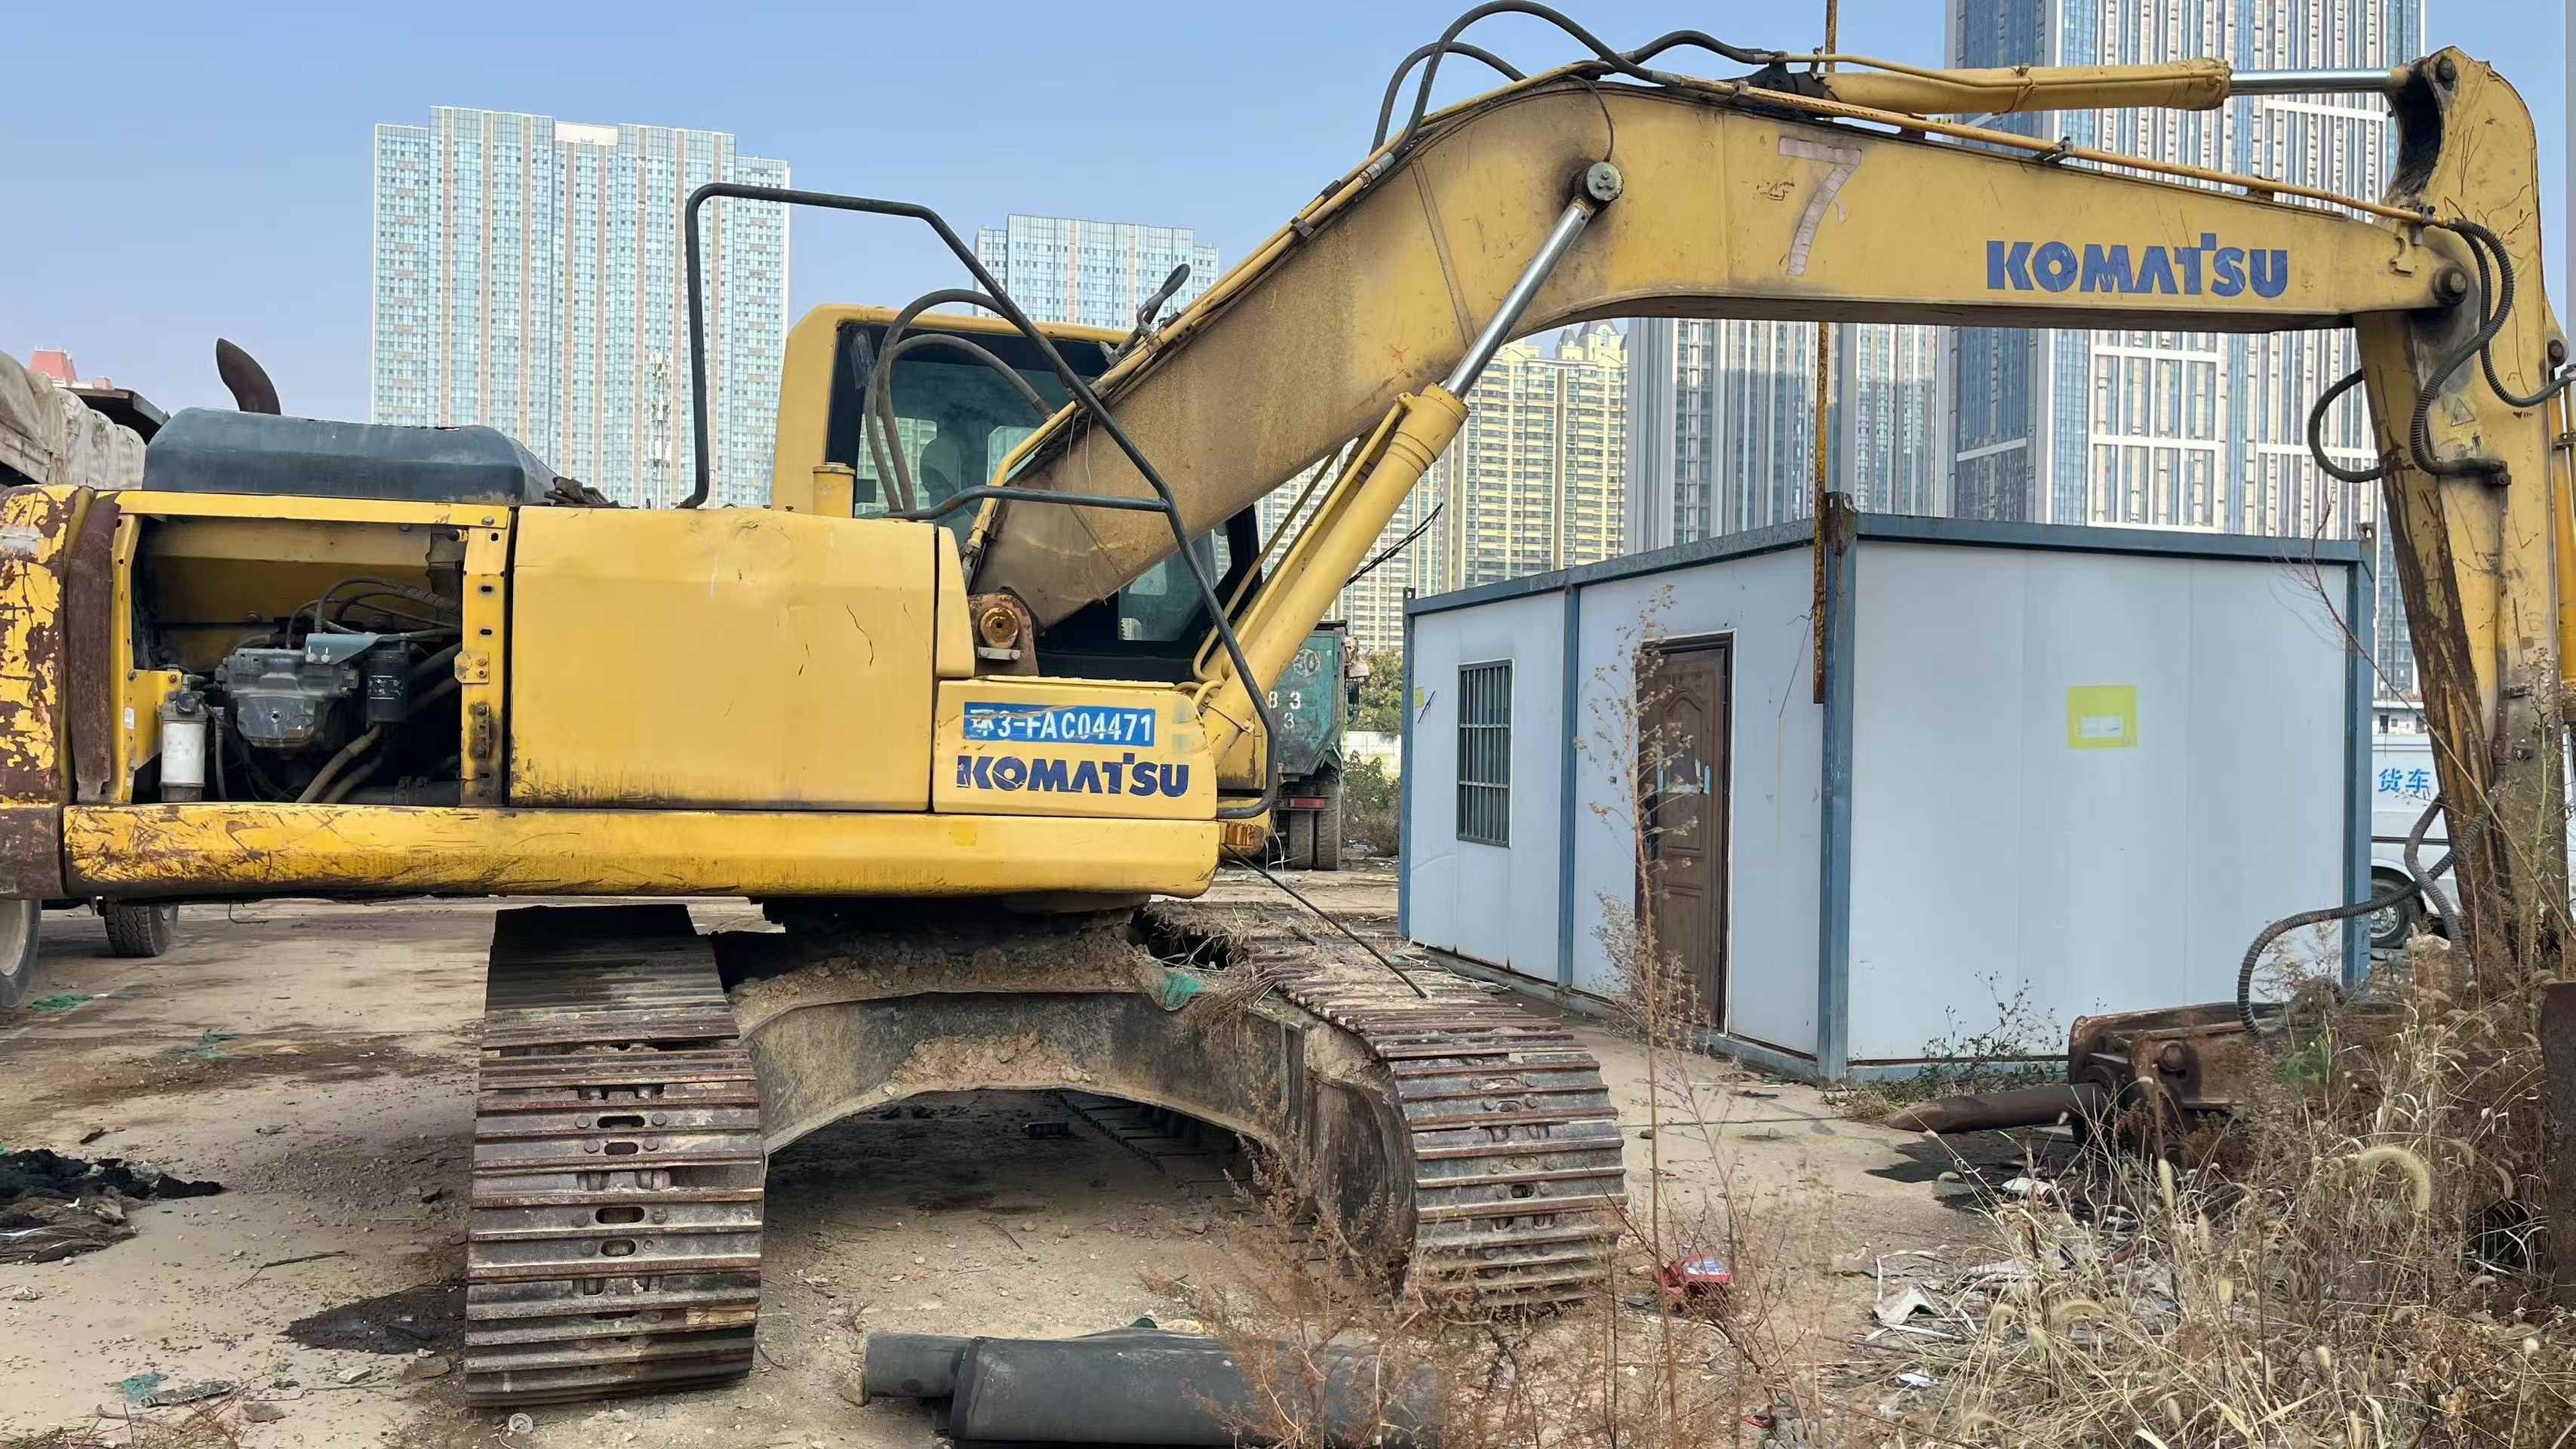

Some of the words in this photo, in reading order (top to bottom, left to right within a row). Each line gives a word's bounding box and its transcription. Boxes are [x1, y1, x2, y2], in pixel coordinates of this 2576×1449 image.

[1987, 233, 2288, 297] KOMATSU
[957, 752, 1189, 797] KOMATSU
[2378, 768, 2430, 792] 货车
